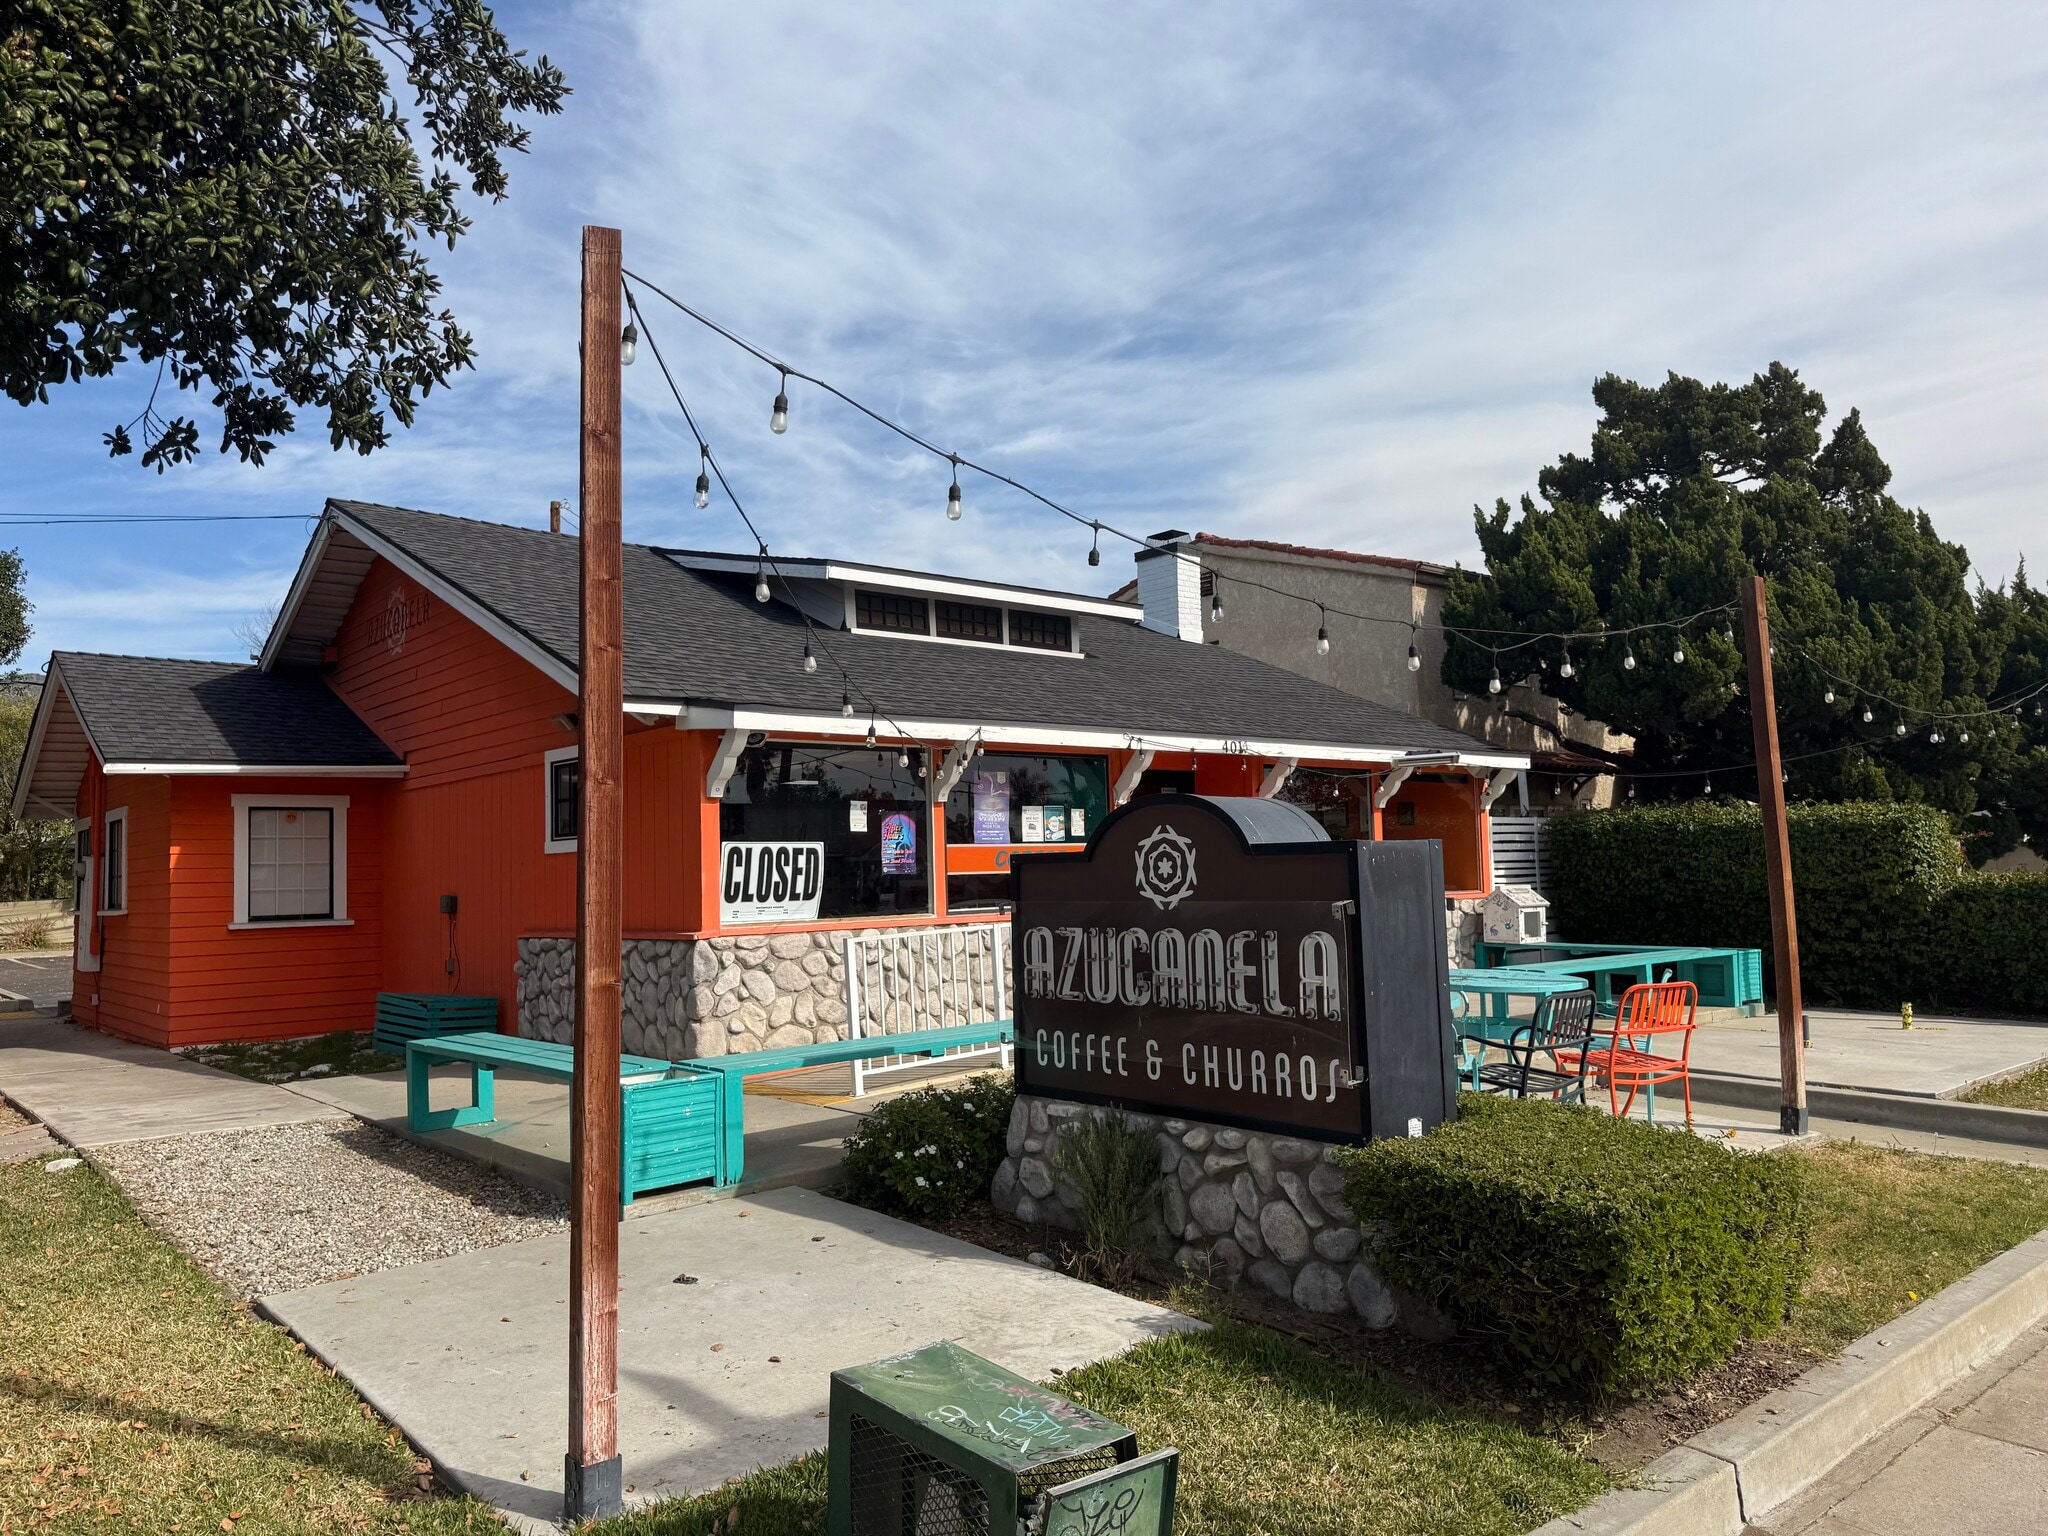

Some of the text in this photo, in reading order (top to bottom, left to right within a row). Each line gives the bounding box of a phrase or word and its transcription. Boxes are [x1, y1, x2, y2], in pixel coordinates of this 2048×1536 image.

[723, 845, 820, 904] CLOSED
[1023, 926, 1342, 1022] AZUCANELA
[1036, 1027, 1340, 1104] COFFEE & CHURROS
